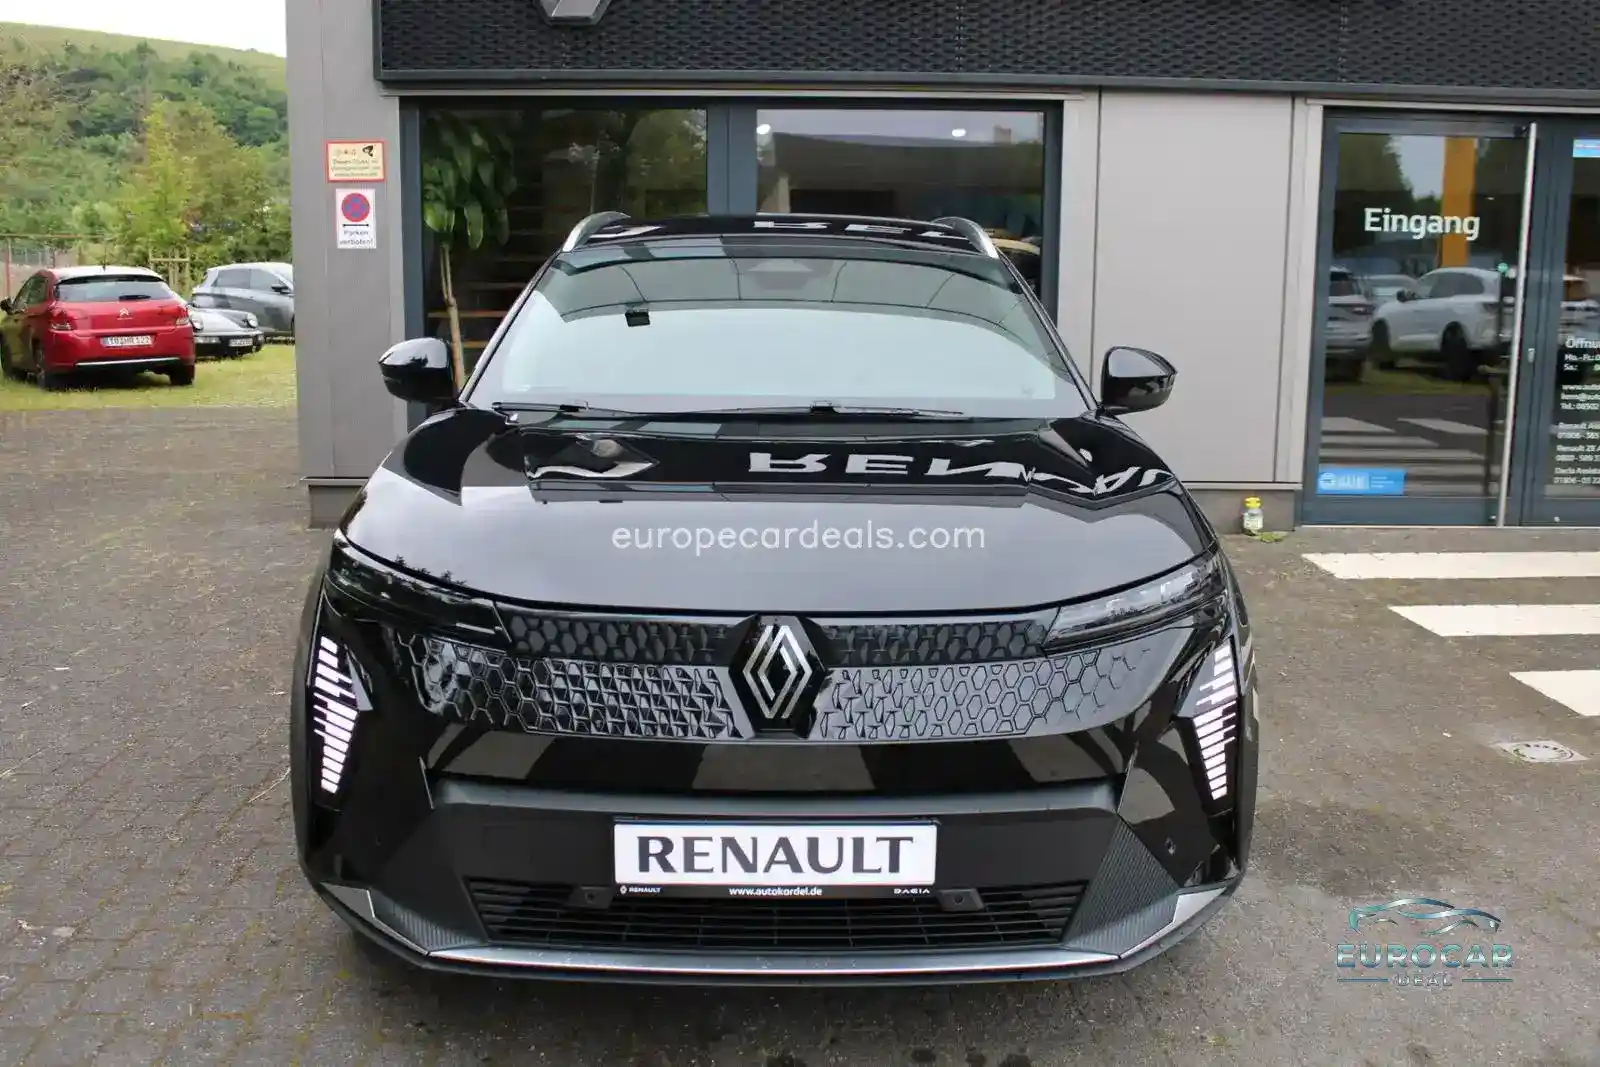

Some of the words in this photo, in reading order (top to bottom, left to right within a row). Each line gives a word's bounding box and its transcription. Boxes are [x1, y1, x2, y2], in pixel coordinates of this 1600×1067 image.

[1364, 208, 1480, 240] Eingang
[637, 836, 914, 873] RENAULT
[728, 887, 823, 896] www.autokordel.de
